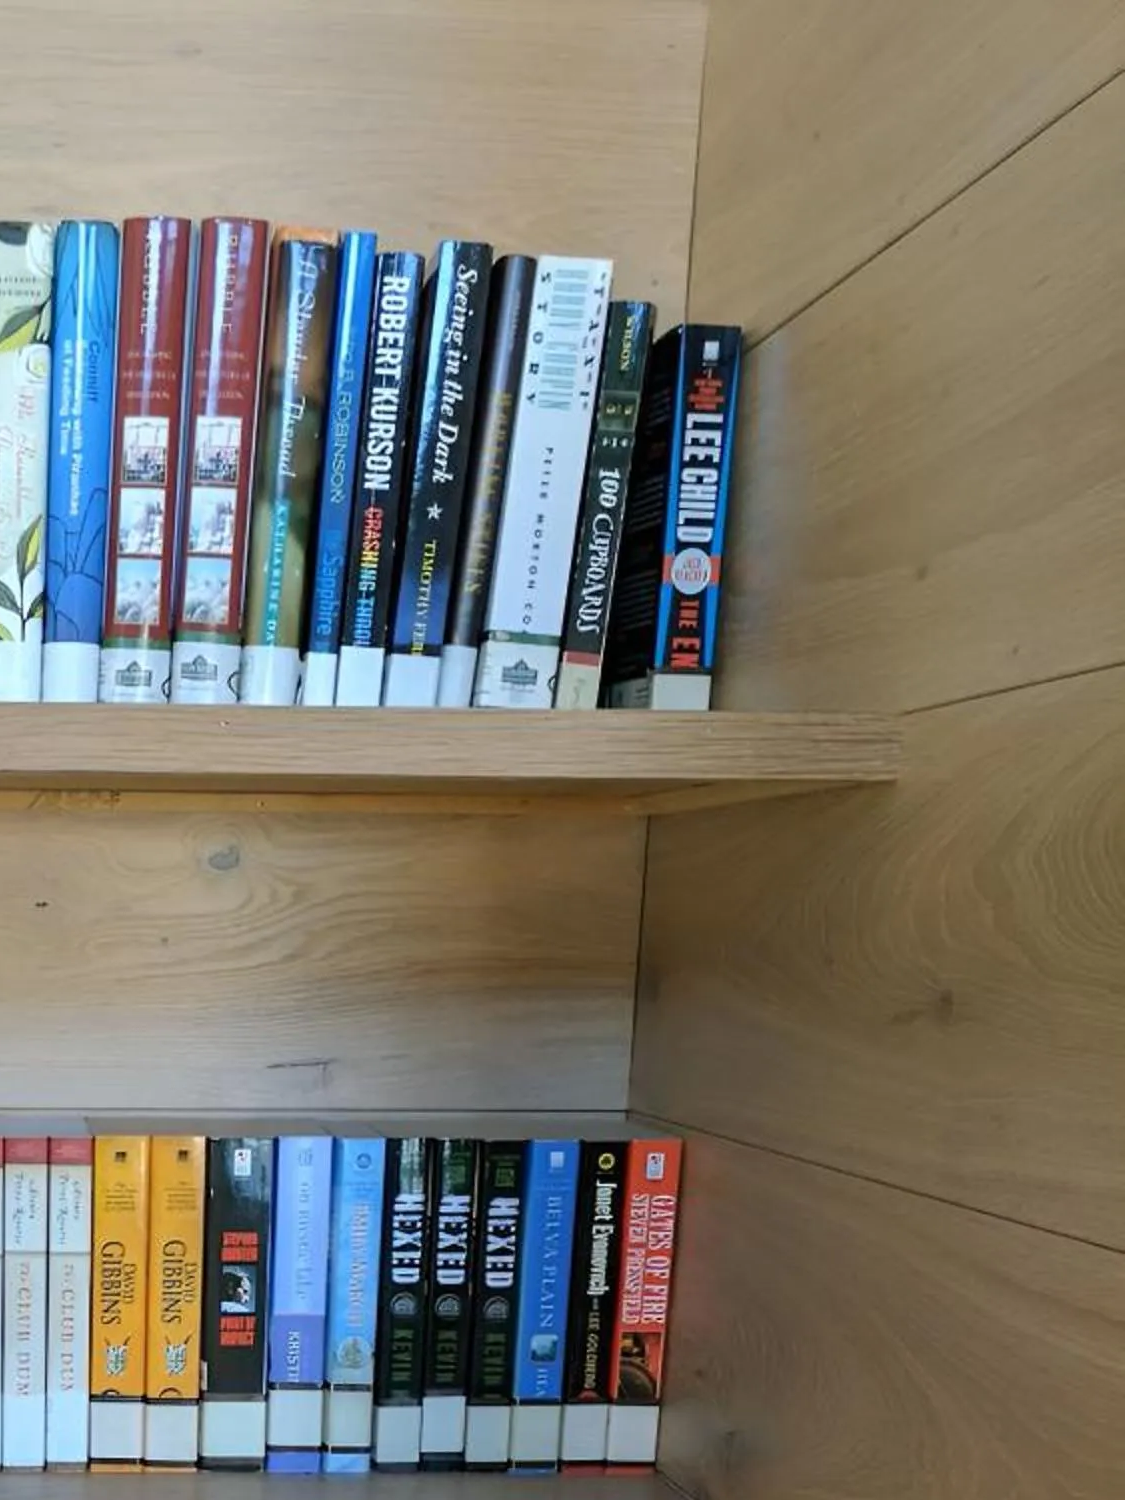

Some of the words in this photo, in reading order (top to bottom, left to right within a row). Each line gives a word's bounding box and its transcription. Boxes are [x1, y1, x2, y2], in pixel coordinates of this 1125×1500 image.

[377, 275, 410, 378] ROBERT
[445, 264, 478, 344] Seeing
[527, 271, 552, 404] STORY
[438, 379, 462, 417] the
[445, 348, 467, 376] in
[328, 393, 353, 505] ROBINSON
[363, 386, 395, 492] KURSON
[431, 420, 459, 485] Dark
[682, 412, 723, 466] LEE
[596, 466, 620, 506] 100
[676, 468, 719, 545] CHILD
[359, 505, 385, 592] CRASHING
[413, 538, 437, 616] TIMOTHY
[526, 513, 545, 590] MORTON
[575, 510, 615, 634] CUPBOARDS
[314, 553, 341, 637] Sapphire
[678, 600, 700, 629] THE
[595, 1178, 618, 1220] Janet
[647, 1194, 676, 1250] GATES
[392, 1193, 425, 1284] HEXED
[436, 1194, 471, 1286] HEXED
[484, 1197, 520, 1288] HEXED
[587, 1224, 614, 1296] Evanovich
[644, 1255, 669, 1278] OF
[101, 1240, 125, 1326] GIBBINS
[161, 1239, 186, 1325] GIBBINS
[538, 1264, 559, 1329] PLAIN
[641, 1284, 668, 1325] FIRE
